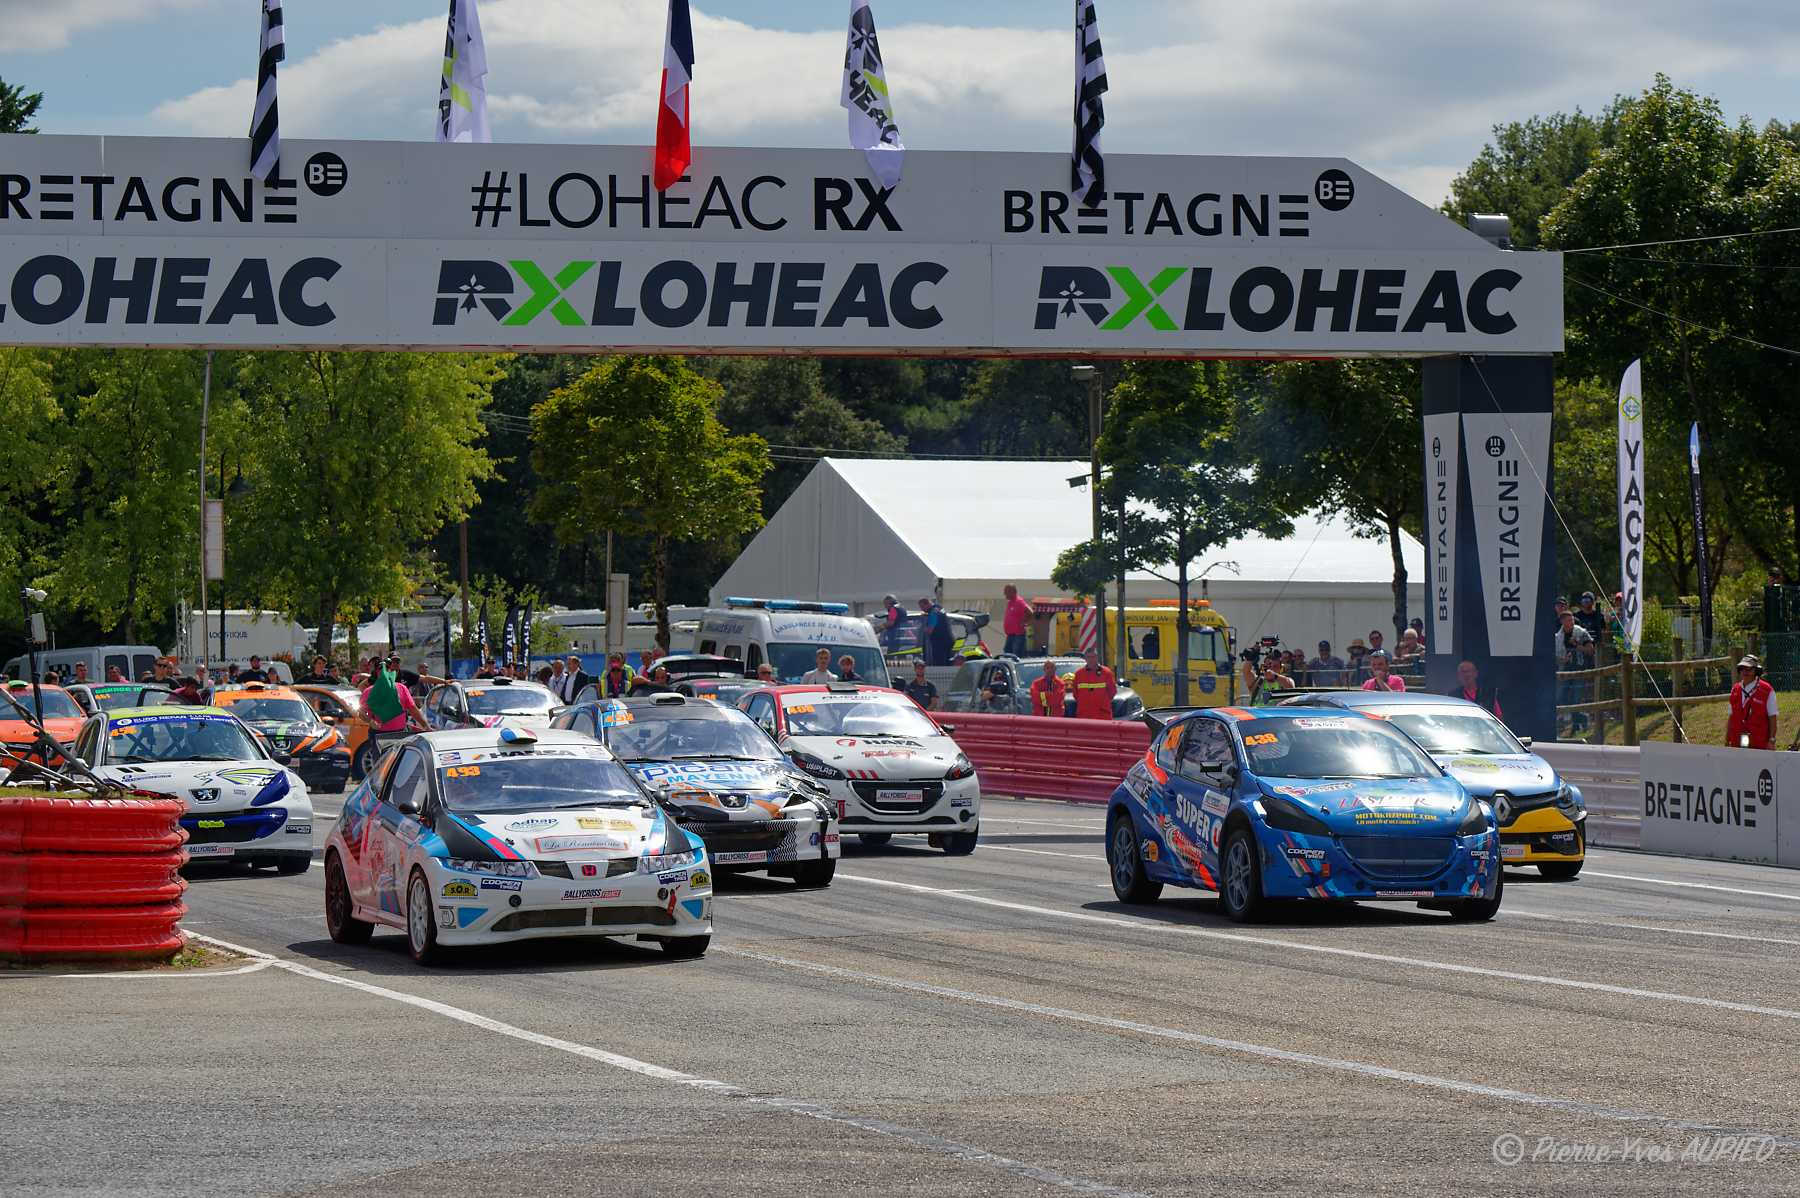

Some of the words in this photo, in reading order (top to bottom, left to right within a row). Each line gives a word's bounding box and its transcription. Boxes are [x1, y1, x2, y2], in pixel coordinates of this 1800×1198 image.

[471, 170, 787, 231] #LOHEAC
[814, 177, 903, 231] RX
[1003, 190, 1310, 238] BRETAGNE
[0, 254, 342, 326] OHEAC
[1437, 460, 1448, 622] BRETAGNE
[1498, 460, 1521, 622] BRETAGNE
[1623, 439, 1642, 620] YACCO
[1176, 794, 1211, 843] SUPER
[1645, 781, 1757, 828] BRETAGNE
[660, 871, 687, 880] COOPER
[1288, 848, 1326, 856] COOPER
[482, 879, 521, 888] COOPER
[563, 889, 602, 898] RALLYCROSS
